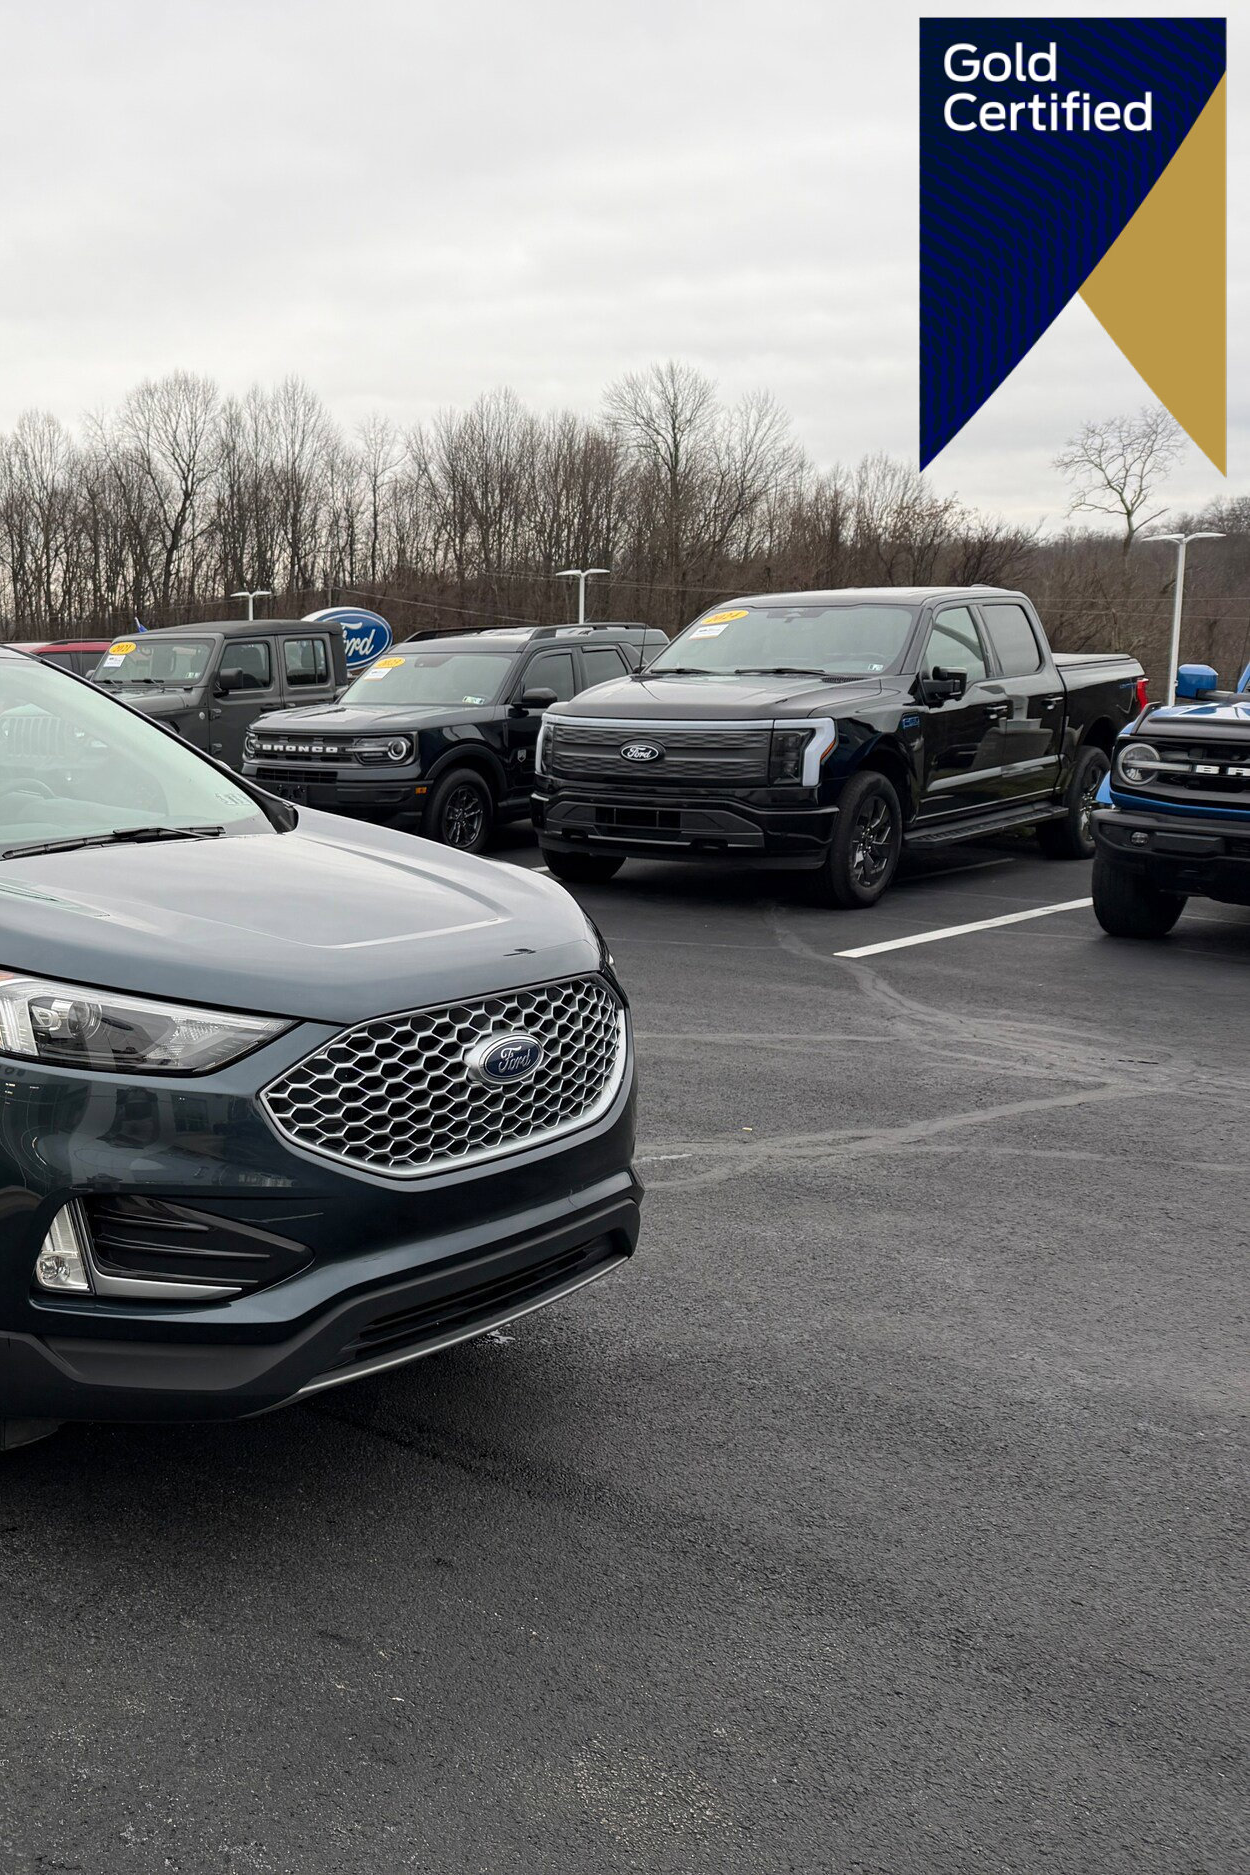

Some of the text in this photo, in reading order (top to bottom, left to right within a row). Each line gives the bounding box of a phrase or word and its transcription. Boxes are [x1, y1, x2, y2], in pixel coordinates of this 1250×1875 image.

[262, 744, 338, 753] BRONCO
[627, 746, 652, 758] Ford
[498, 1045, 531, 1073] Ford
